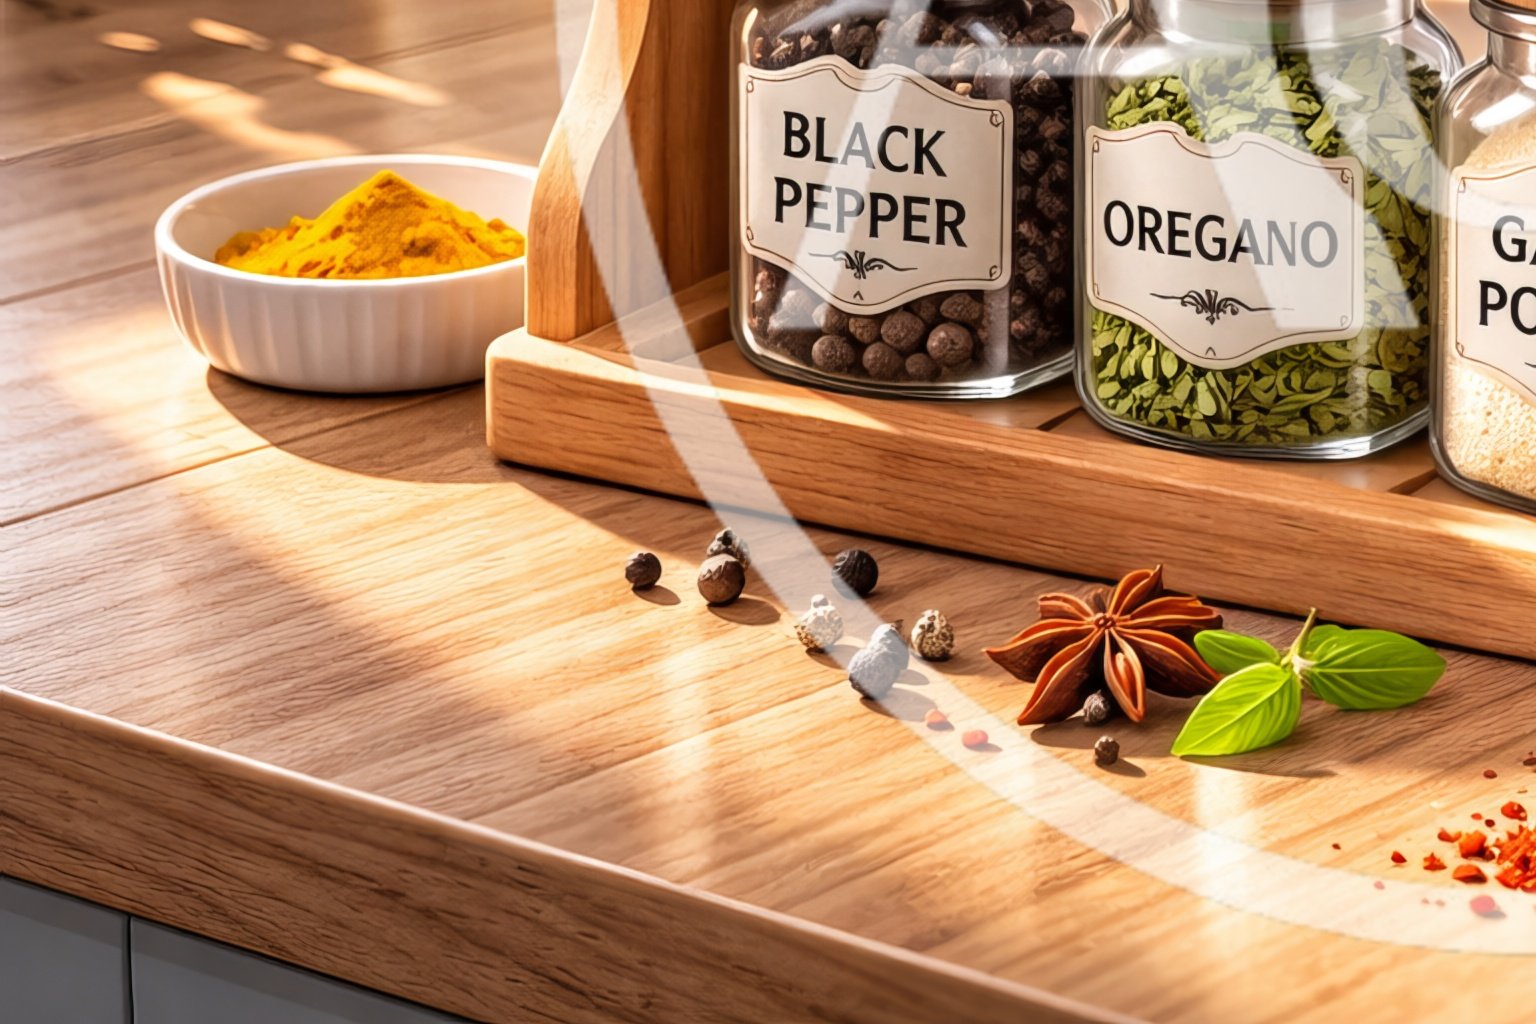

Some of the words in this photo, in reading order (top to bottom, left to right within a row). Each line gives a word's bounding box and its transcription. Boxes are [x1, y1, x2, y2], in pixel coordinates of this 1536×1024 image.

[783, 111, 947, 177] BLACK
[774, 177, 967, 248] PEPPER
[1103, 200, 1339, 268] OREGANO
